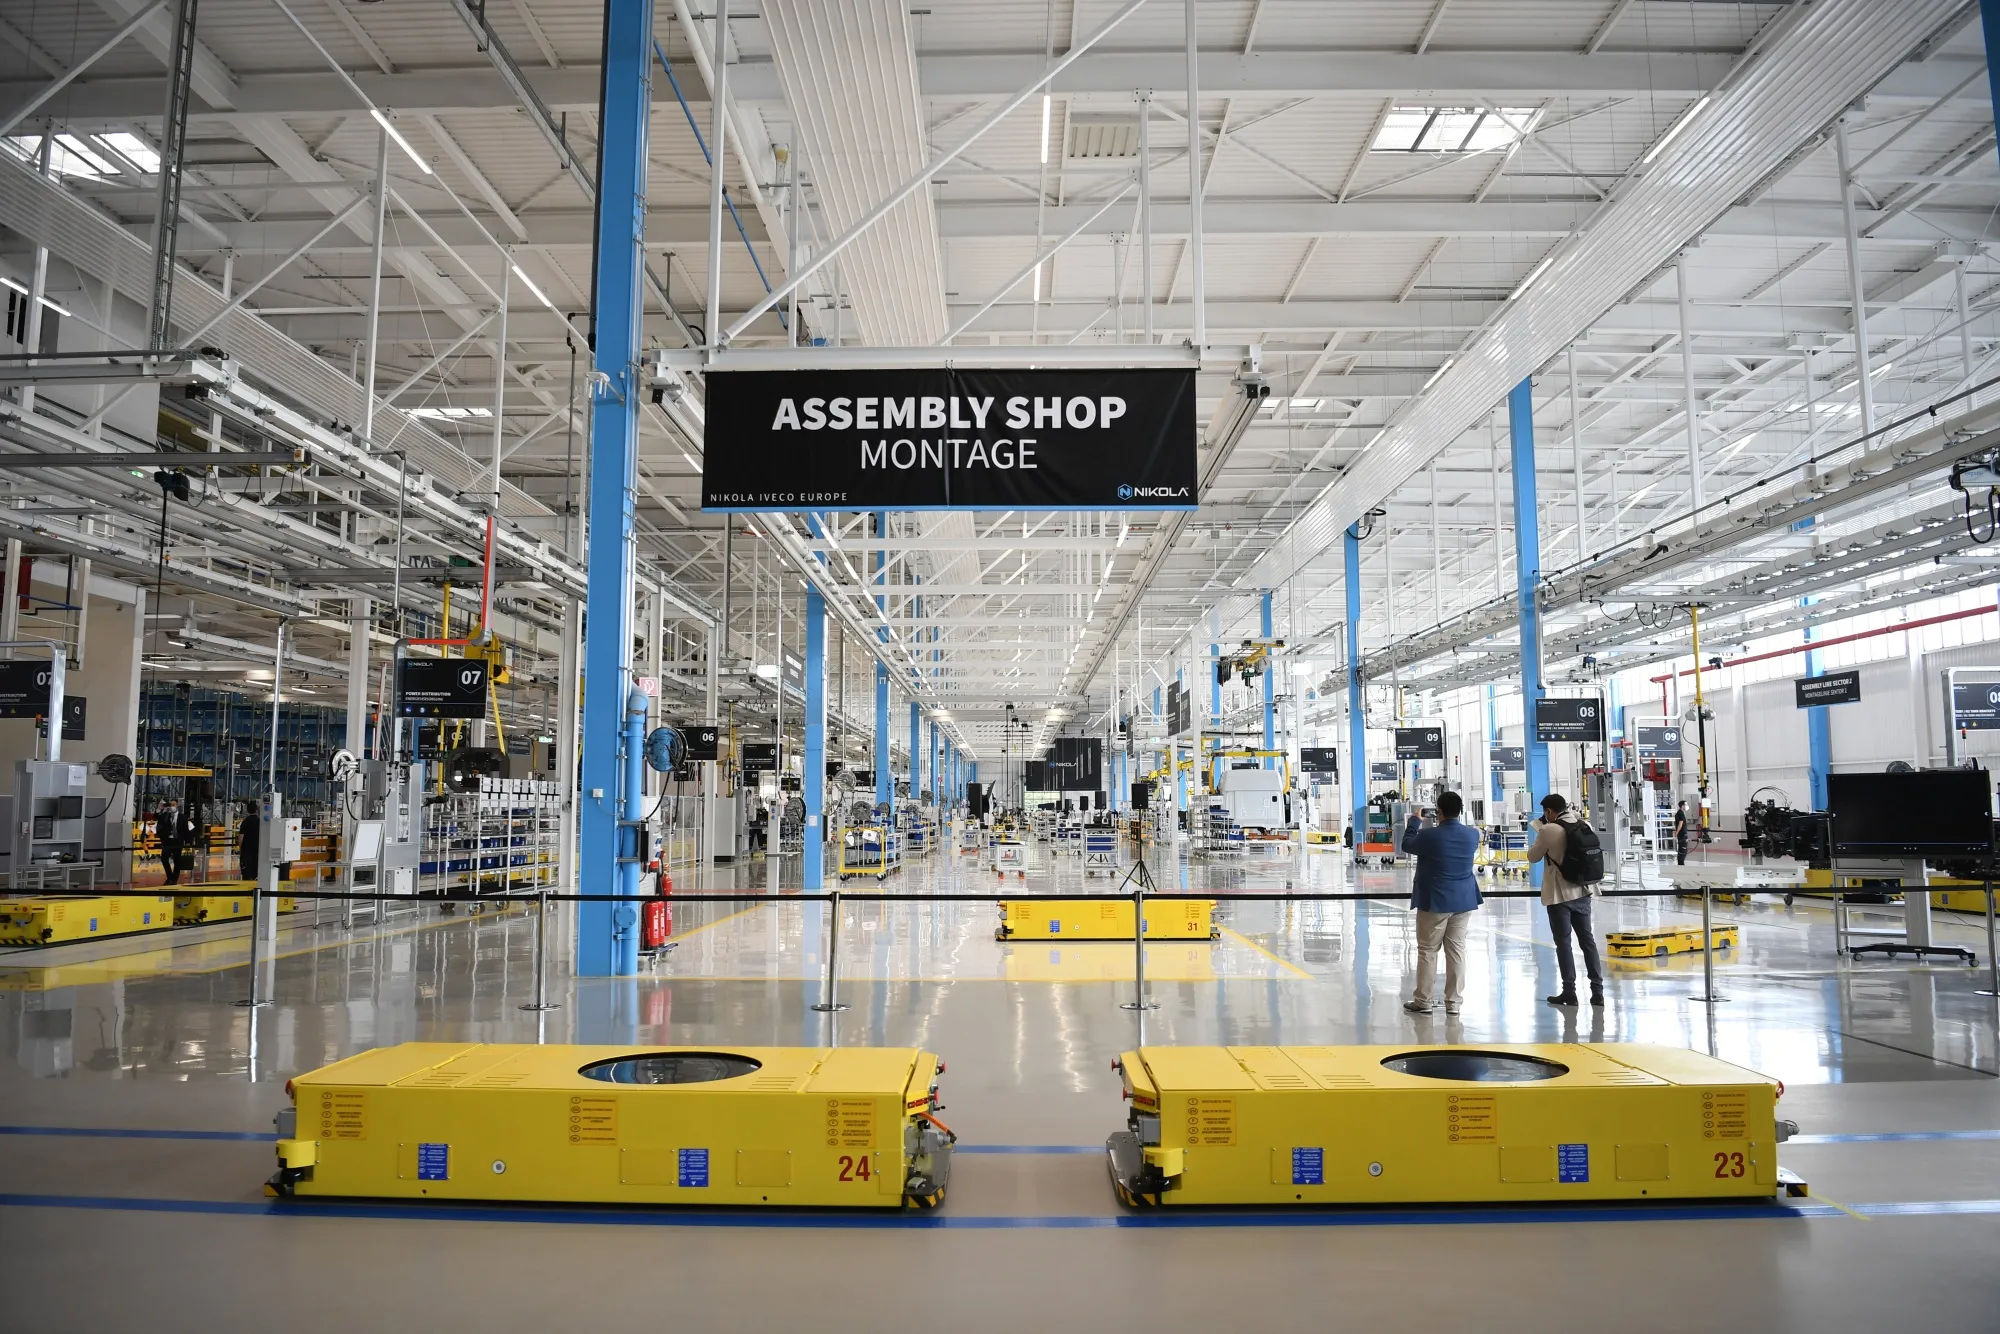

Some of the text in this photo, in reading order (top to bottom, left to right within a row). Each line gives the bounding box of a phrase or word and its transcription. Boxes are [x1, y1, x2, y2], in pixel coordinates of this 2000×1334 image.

[772, 396, 1127, 431] ASSEMBLY SHOP
[861, 438, 1038, 469] MONTAGE
[710, 492, 848, 502] NIKOLA IVECO EUROPE
[1134, 487, 1190, 498] NIKOLA
[461, 671, 482, 685] 07
[1802, 683, 1823, 691] ASSEMBLY
[1833, 679, 1848, 687] SECTOR
[74, 706, 80, 715] Q
[1579, 706, 1595, 717] 08
[702, 733, 715, 742] 06
[1427, 733, 1438, 742] 09
[1665, 732, 1677, 741] 09
[1187, 922, 1198, 932] 31
[838, 1155, 871, 1182] 24
[1714, 1152, 1745, 1178] 23
